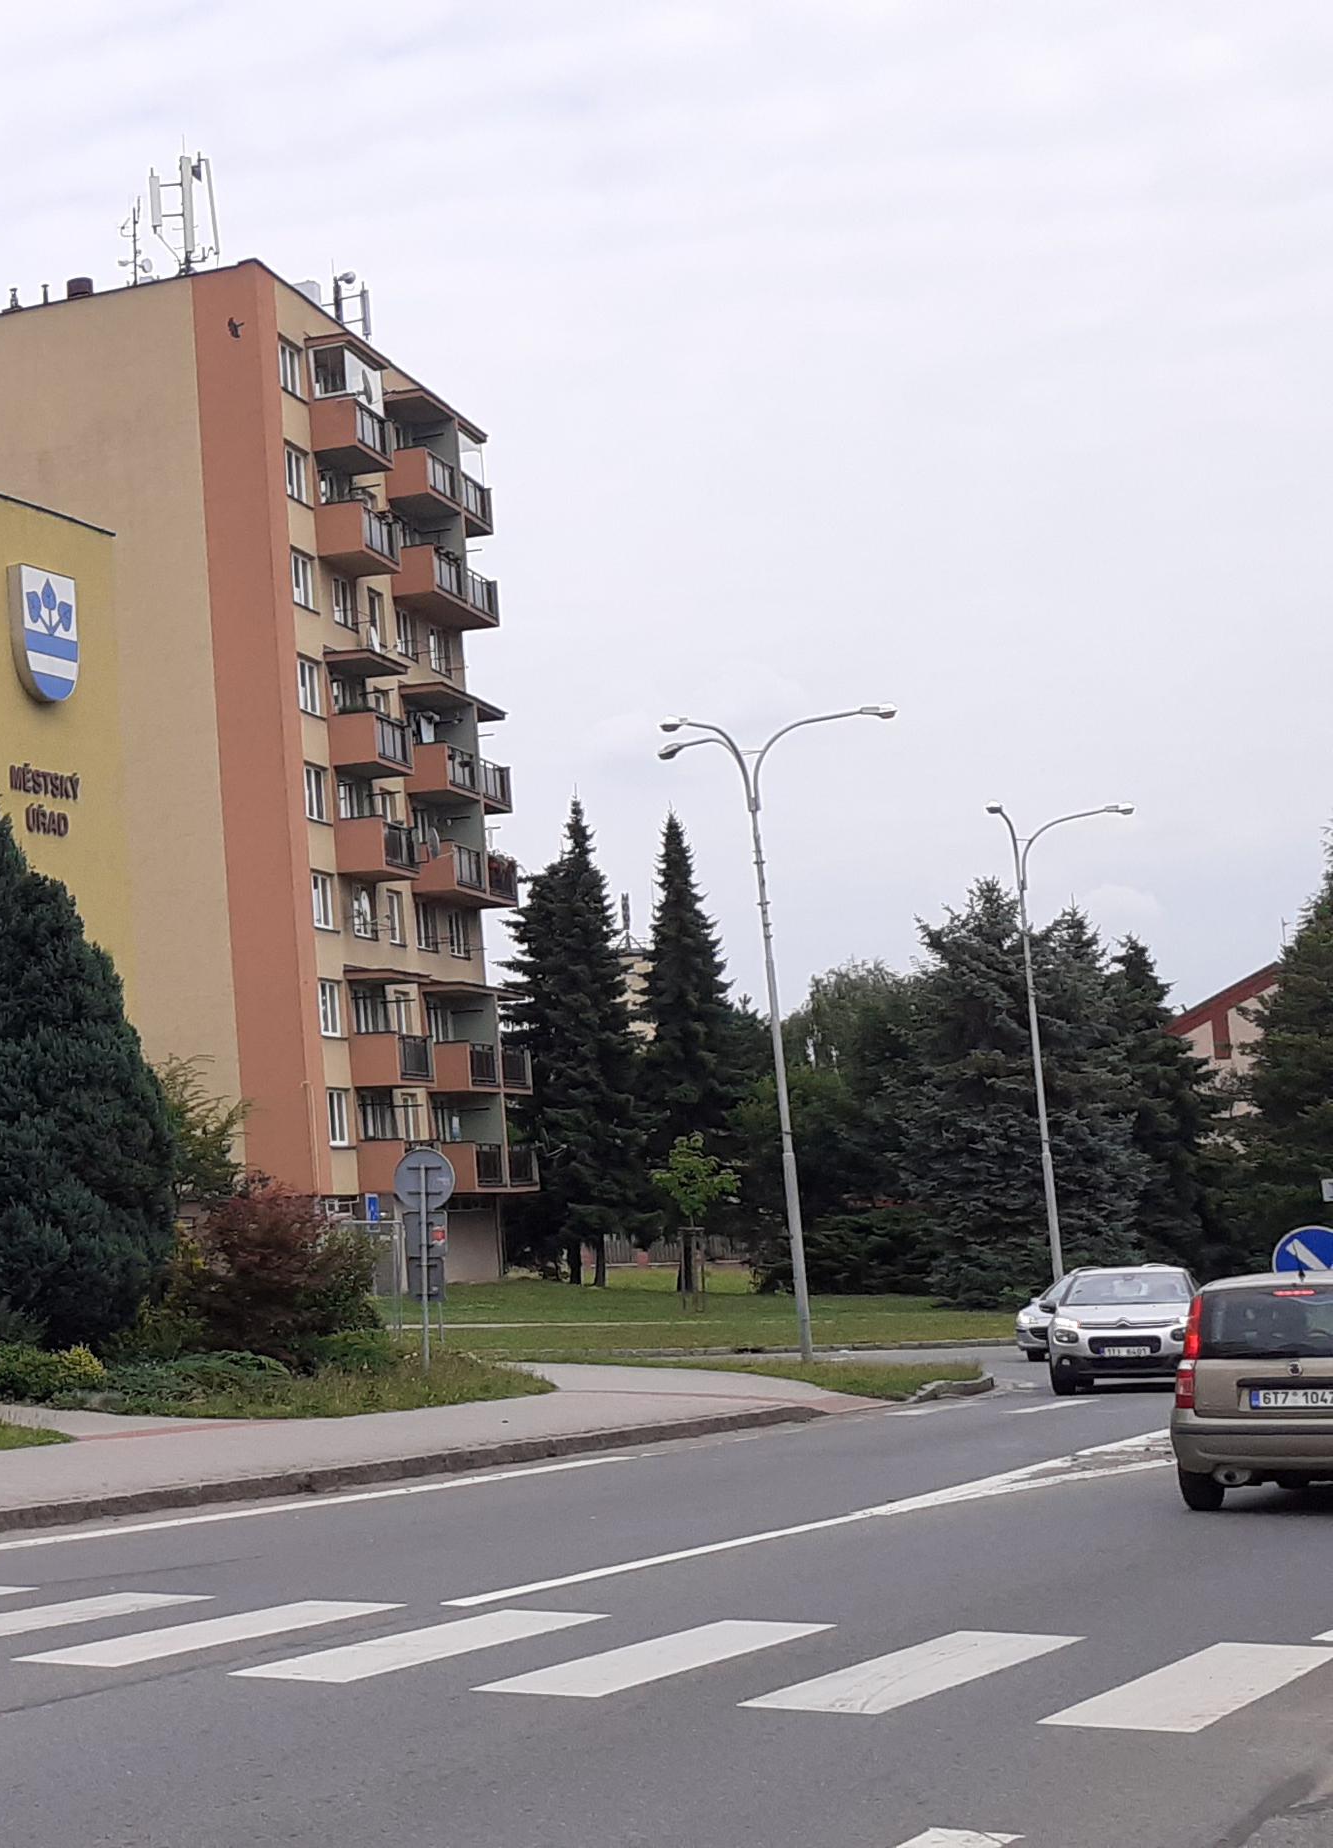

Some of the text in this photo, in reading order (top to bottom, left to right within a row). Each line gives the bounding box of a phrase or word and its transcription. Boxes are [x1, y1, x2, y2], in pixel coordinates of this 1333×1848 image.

[9, 762, 80, 801] MĚSTSKÝ
[25, 802, 69, 838] ÚŘAD
[1262, 1391, 1290, 1405] 6T7
